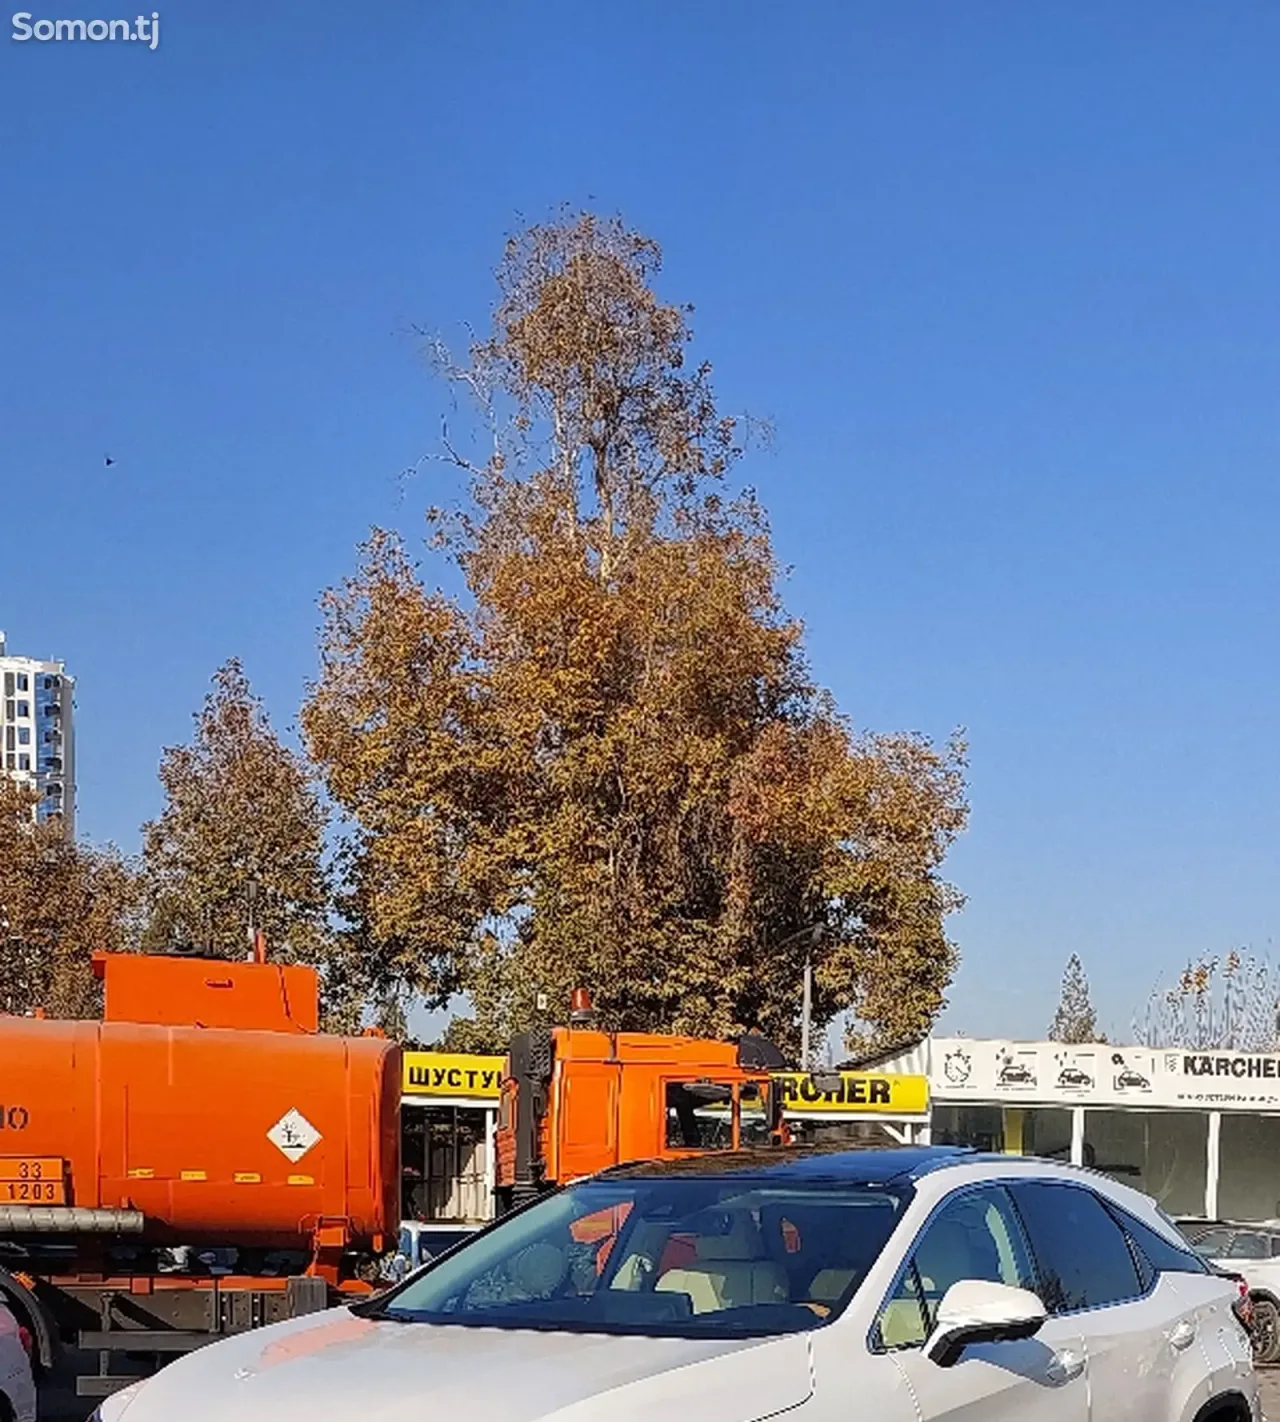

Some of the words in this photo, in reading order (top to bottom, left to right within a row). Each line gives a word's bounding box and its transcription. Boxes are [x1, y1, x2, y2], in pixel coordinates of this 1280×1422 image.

[1184, 1055, 1280, 1078] KÄRCHE
[19, 1162, 41, 1179] 33
[8, 1184, 54, 1200] 1203
